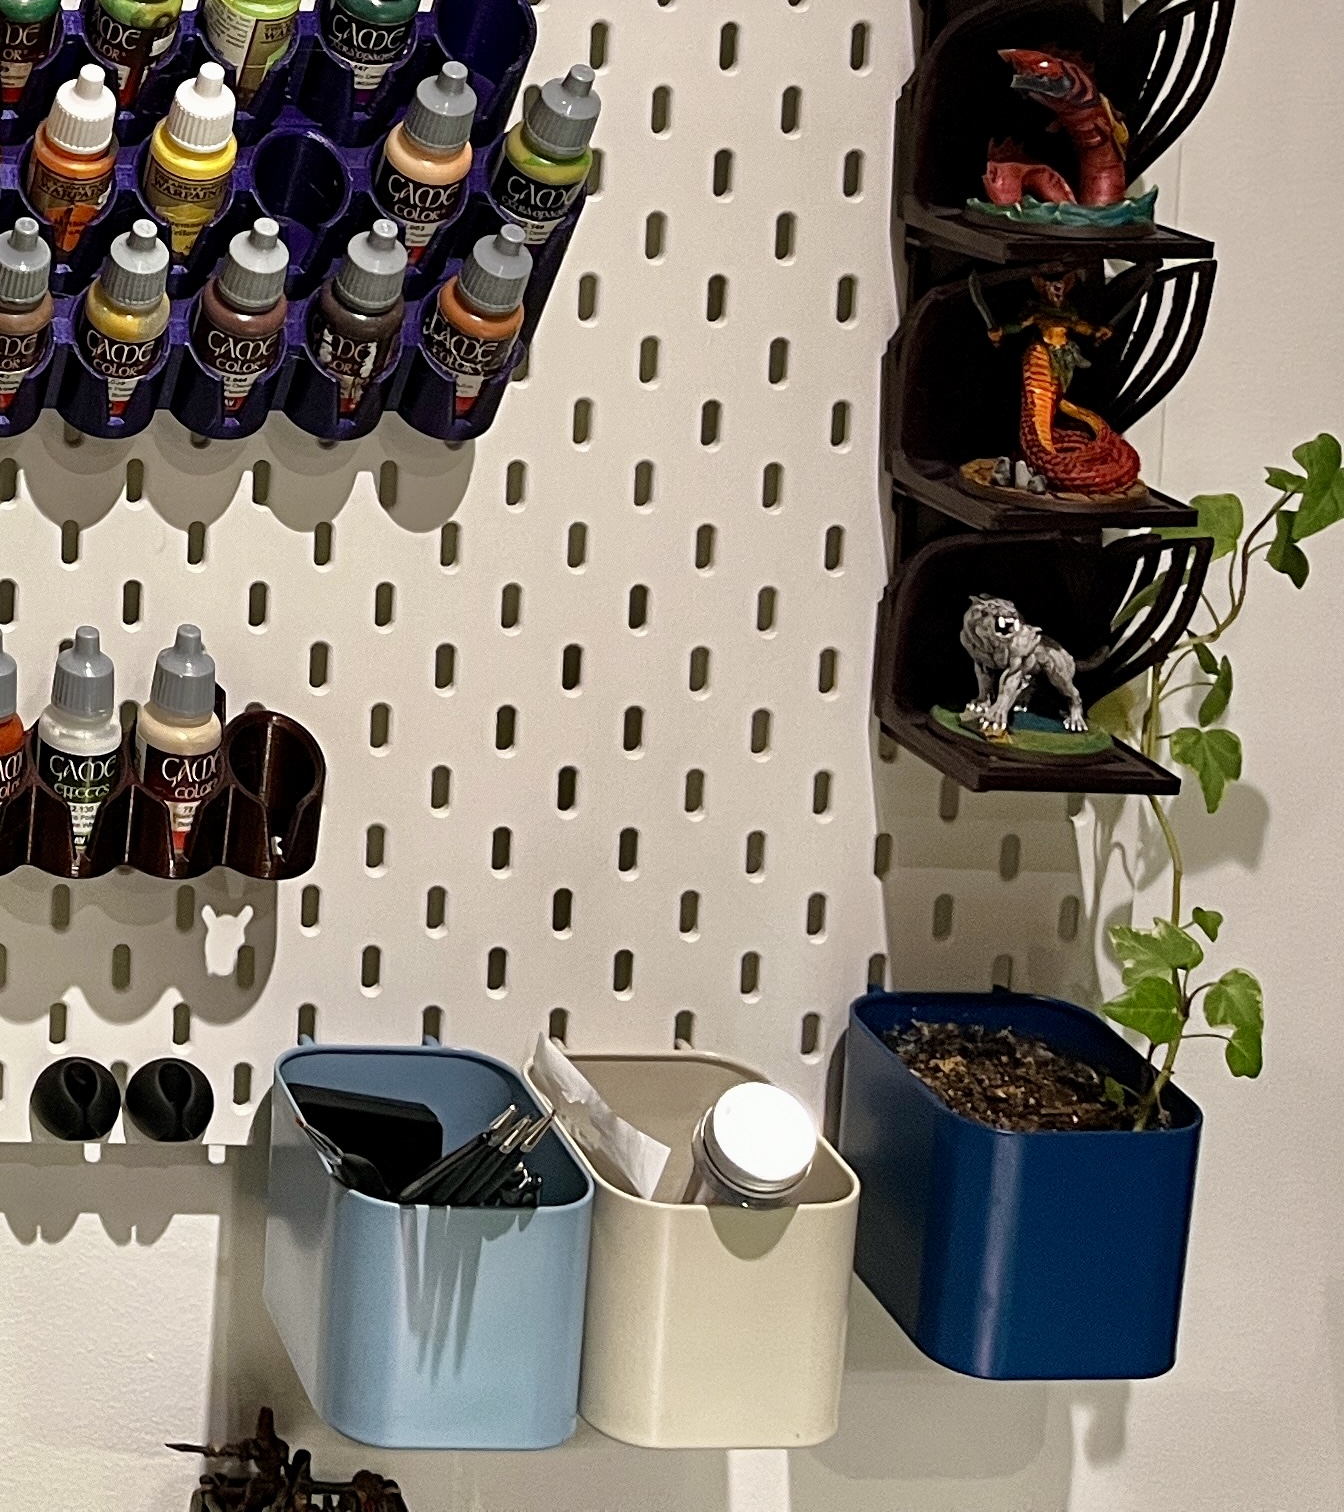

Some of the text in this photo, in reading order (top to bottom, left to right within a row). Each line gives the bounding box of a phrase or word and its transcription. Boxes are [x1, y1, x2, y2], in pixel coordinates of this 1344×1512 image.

[93, 12, 140, 50] AME
[333, 14, 406, 49] GAME
[389, 175, 460, 208] GAME
[395, 203, 441, 221] COLOR
[87, 330, 155, 363] GAME
[208, 330, 278, 360] GAME
[93, 359, 137, 377] COLOR
[50, 755, 116, 782] GAME
[162, 750, 218, 787] GAM
